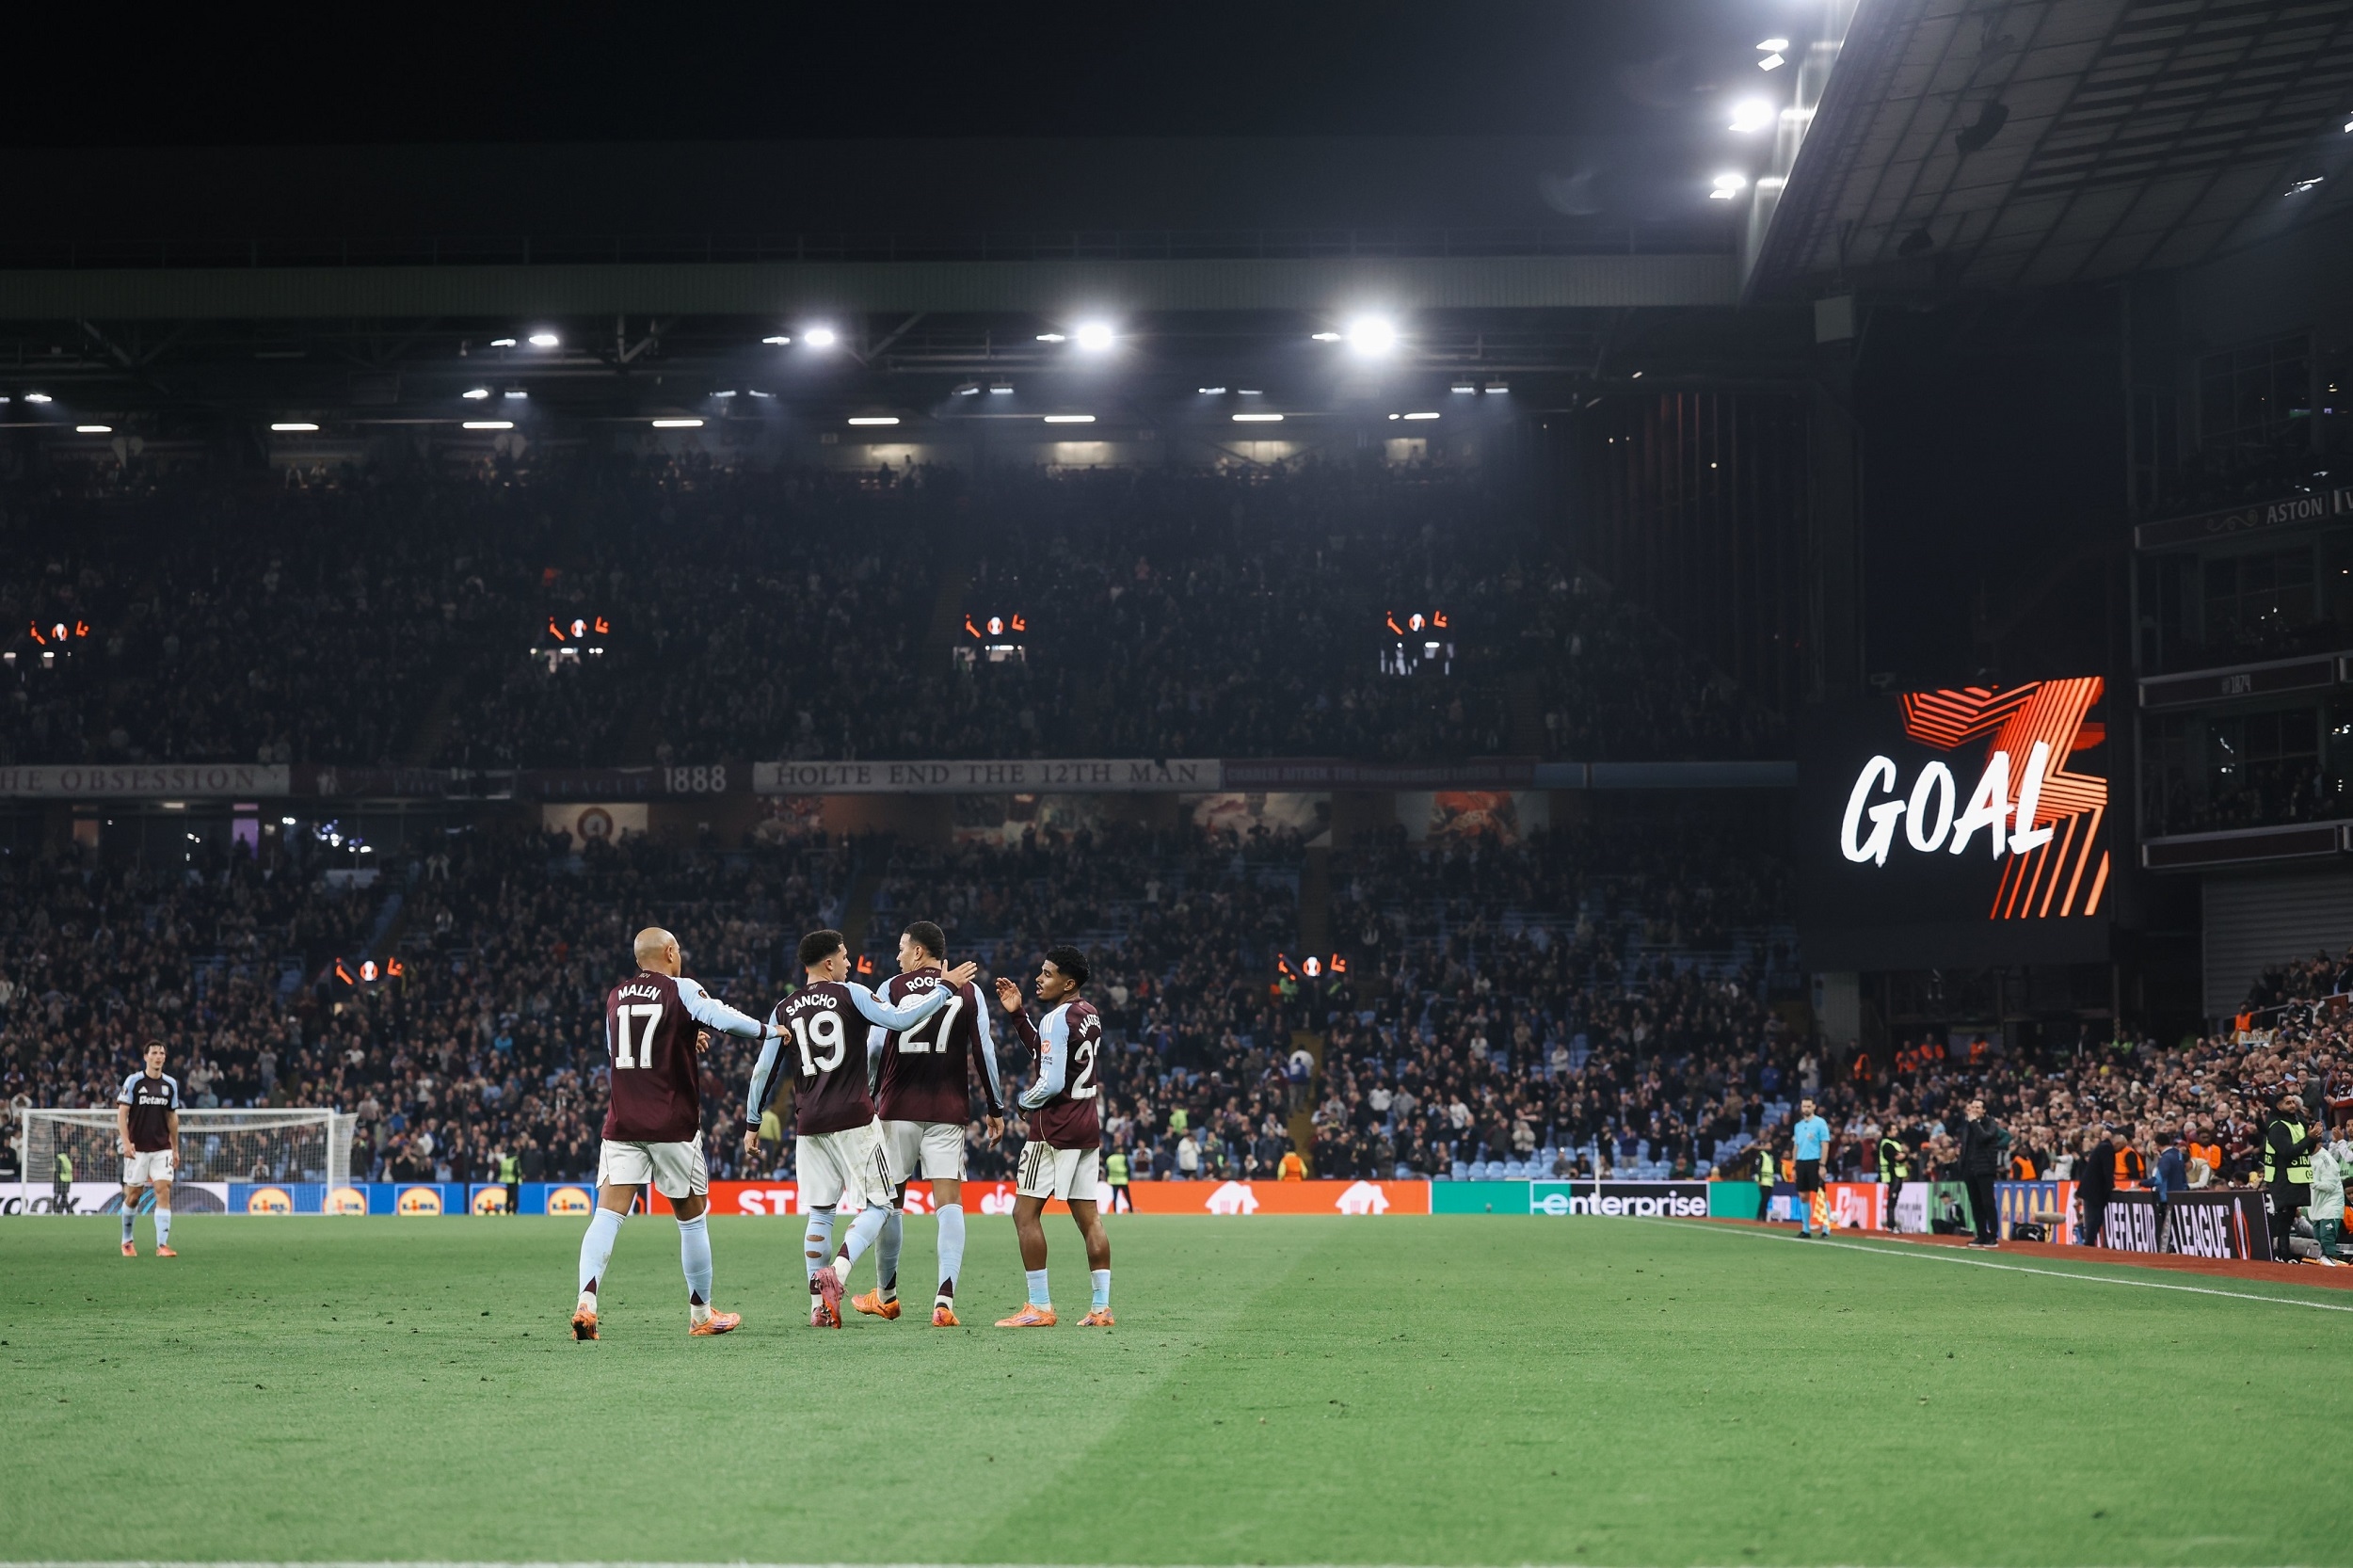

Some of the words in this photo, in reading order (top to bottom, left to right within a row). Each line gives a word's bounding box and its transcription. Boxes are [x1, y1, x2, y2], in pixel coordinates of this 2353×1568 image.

[2266, 497, 2322, 524] ASTON
[60, 771, 255, 792] OBSESSION
[663, 765, 726, 793] 1888
[776, 764, 872, 786] HOLTE
[889, 764, 949, 785] END
[964, 763, 1024, 784] THE
[1042, 763, 1112, 784] 12TH
[1129, 763, 1197, 784] MAN
[1841, 740, 2054, 867] GOAL
[618, 984, 661, 1001] MALEN
[905, 976, 942, 992] ROGE
[786, 993, 838, 1016] SANCHO
[616, 1003, 664, 1069] 17
[899, 994, 964, 1054] 27
[791, 1010, 847, 1077] 19
[1071, 1039, 1101, 1099] 2
[1544, 1191, 1706, 1216] enterprise
[2105, 1202, 2135, 1251] UEFA
[2172, 1204, 2231, 1259] LEAGUE
